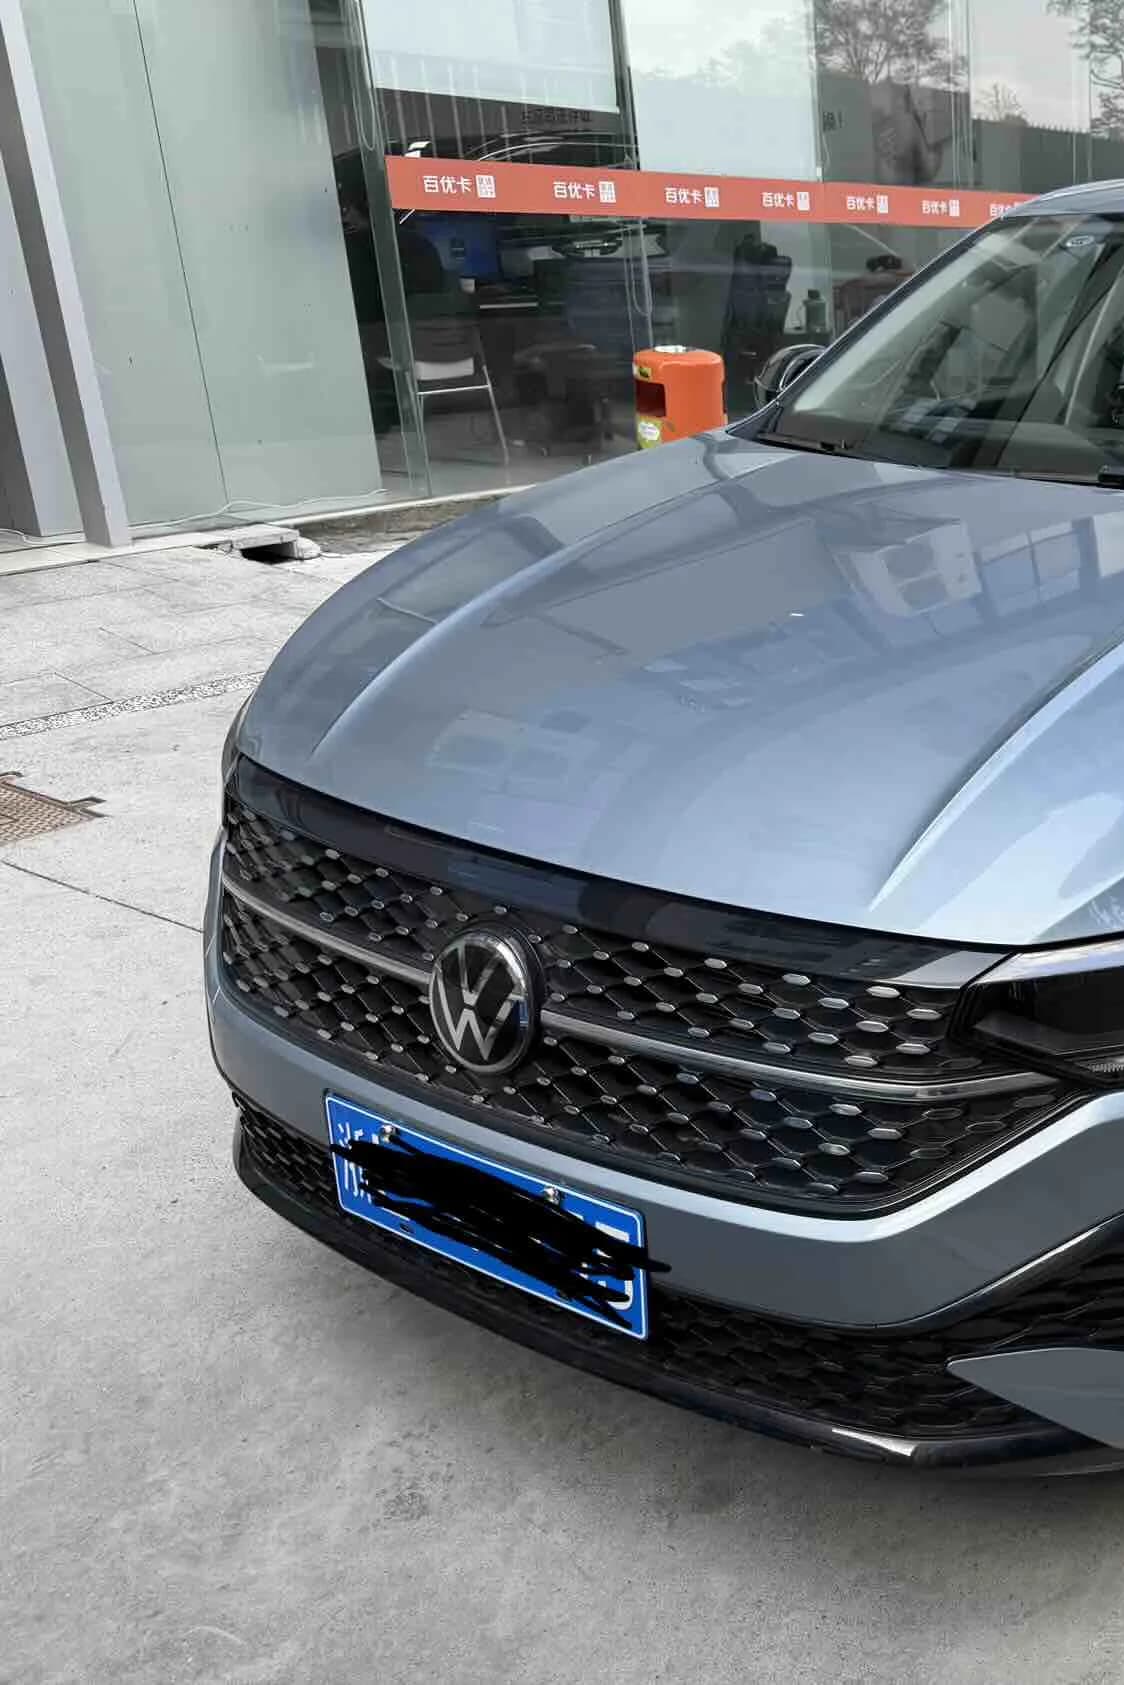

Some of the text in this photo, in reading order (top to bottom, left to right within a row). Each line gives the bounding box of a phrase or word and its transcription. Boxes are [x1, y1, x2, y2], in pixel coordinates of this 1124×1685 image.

[423, 175, 472, 193] 百优卡
[553, 181, 595, 199] 百优卡
[665, 187, 703, 204] 百优卡
[762, 192, 794, 207] 百优卡
[434, 941, 528, 1063] VW
